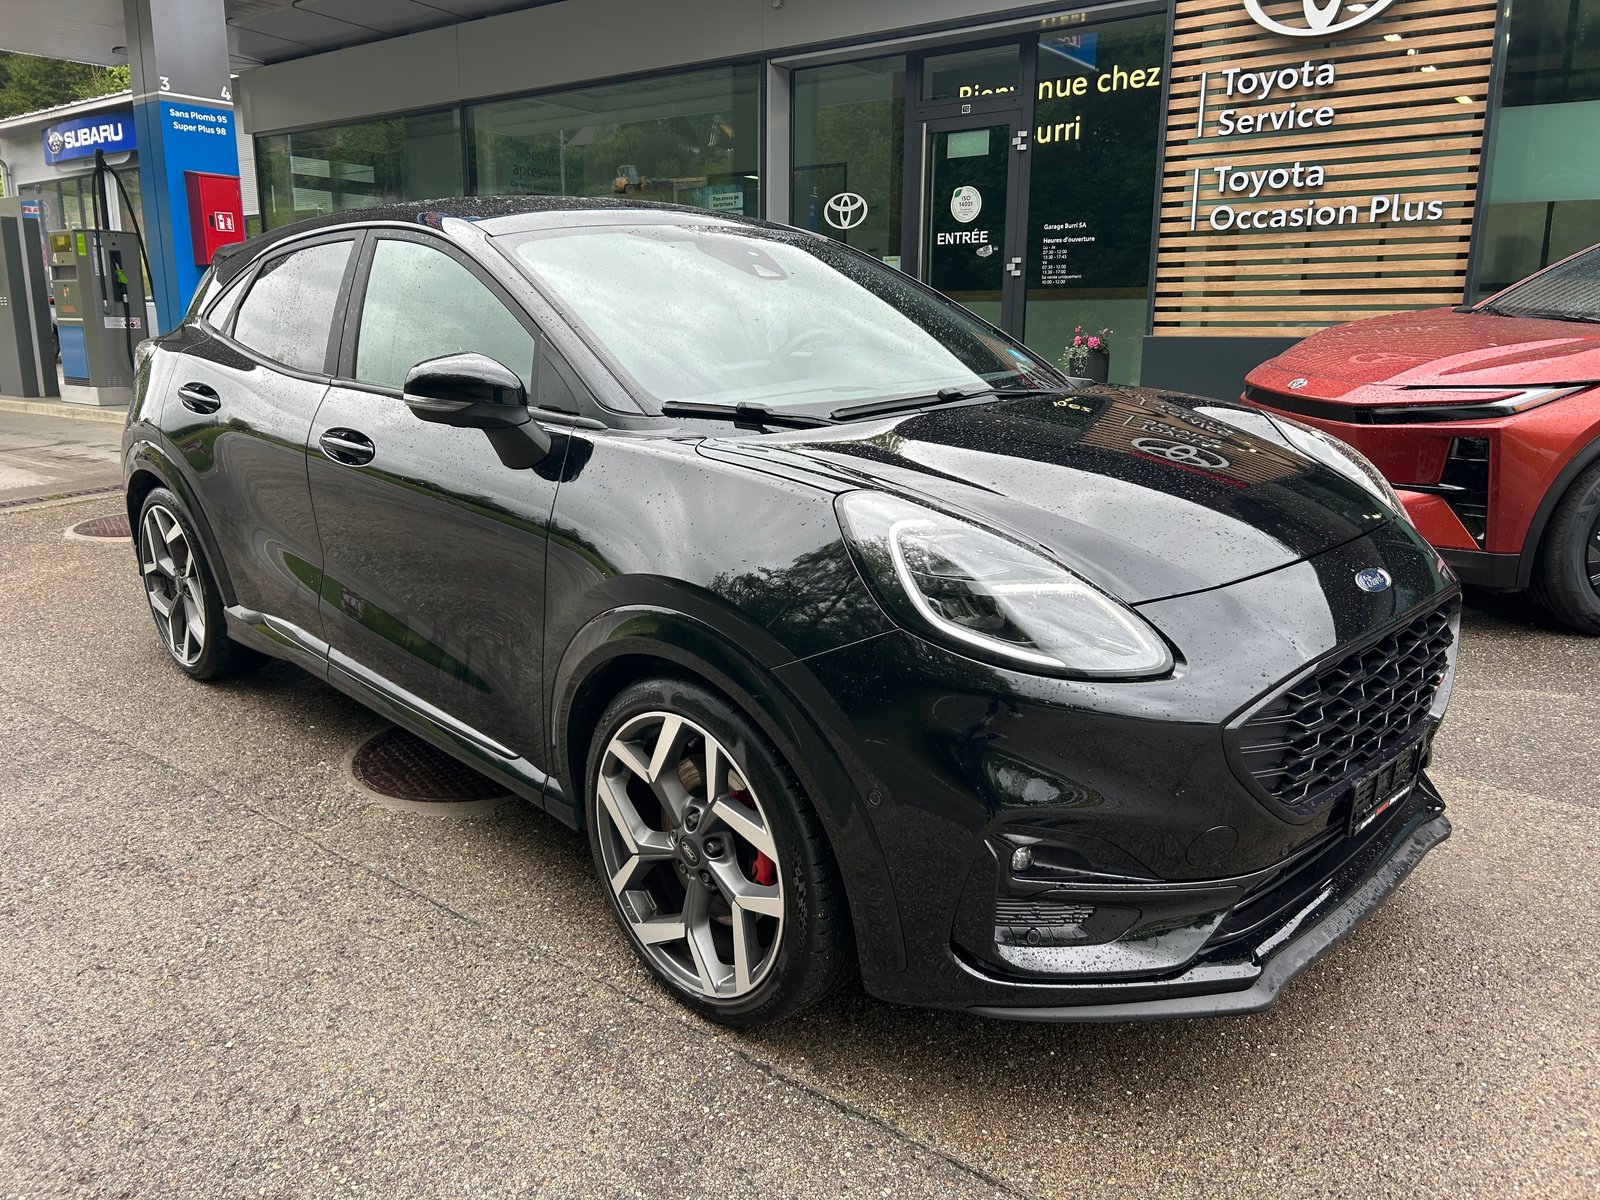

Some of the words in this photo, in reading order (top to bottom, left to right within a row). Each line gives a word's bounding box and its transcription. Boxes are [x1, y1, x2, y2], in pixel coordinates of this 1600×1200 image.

[159, 76, 170, 91] 3
[1097, 64, 1161, 93] chez
[1222, 61, 1335, 100] Toyota
[221, 86, 231, 100] 4
[169, 108, 189, 118] Sans
[190, 111, 216, 122] Plomb
[217, 115, 228, 124] 95
[1217, 102, 1335, 136] Service
[64, 122, 123, 149] SUBARU
[173, 121, 197, 132] Super
[197, 125, 215, 134] Plus
[215, 127, 226, 135] 98
[1214, 161, 1324, 198] Toyota
[1209, 199, 1359, 231] Occasion
[1369, 193, 1443, 223] Plus
[937, 228, 988, 245] ENTRÉE
[1043, 223, 1064, 231] Garage
